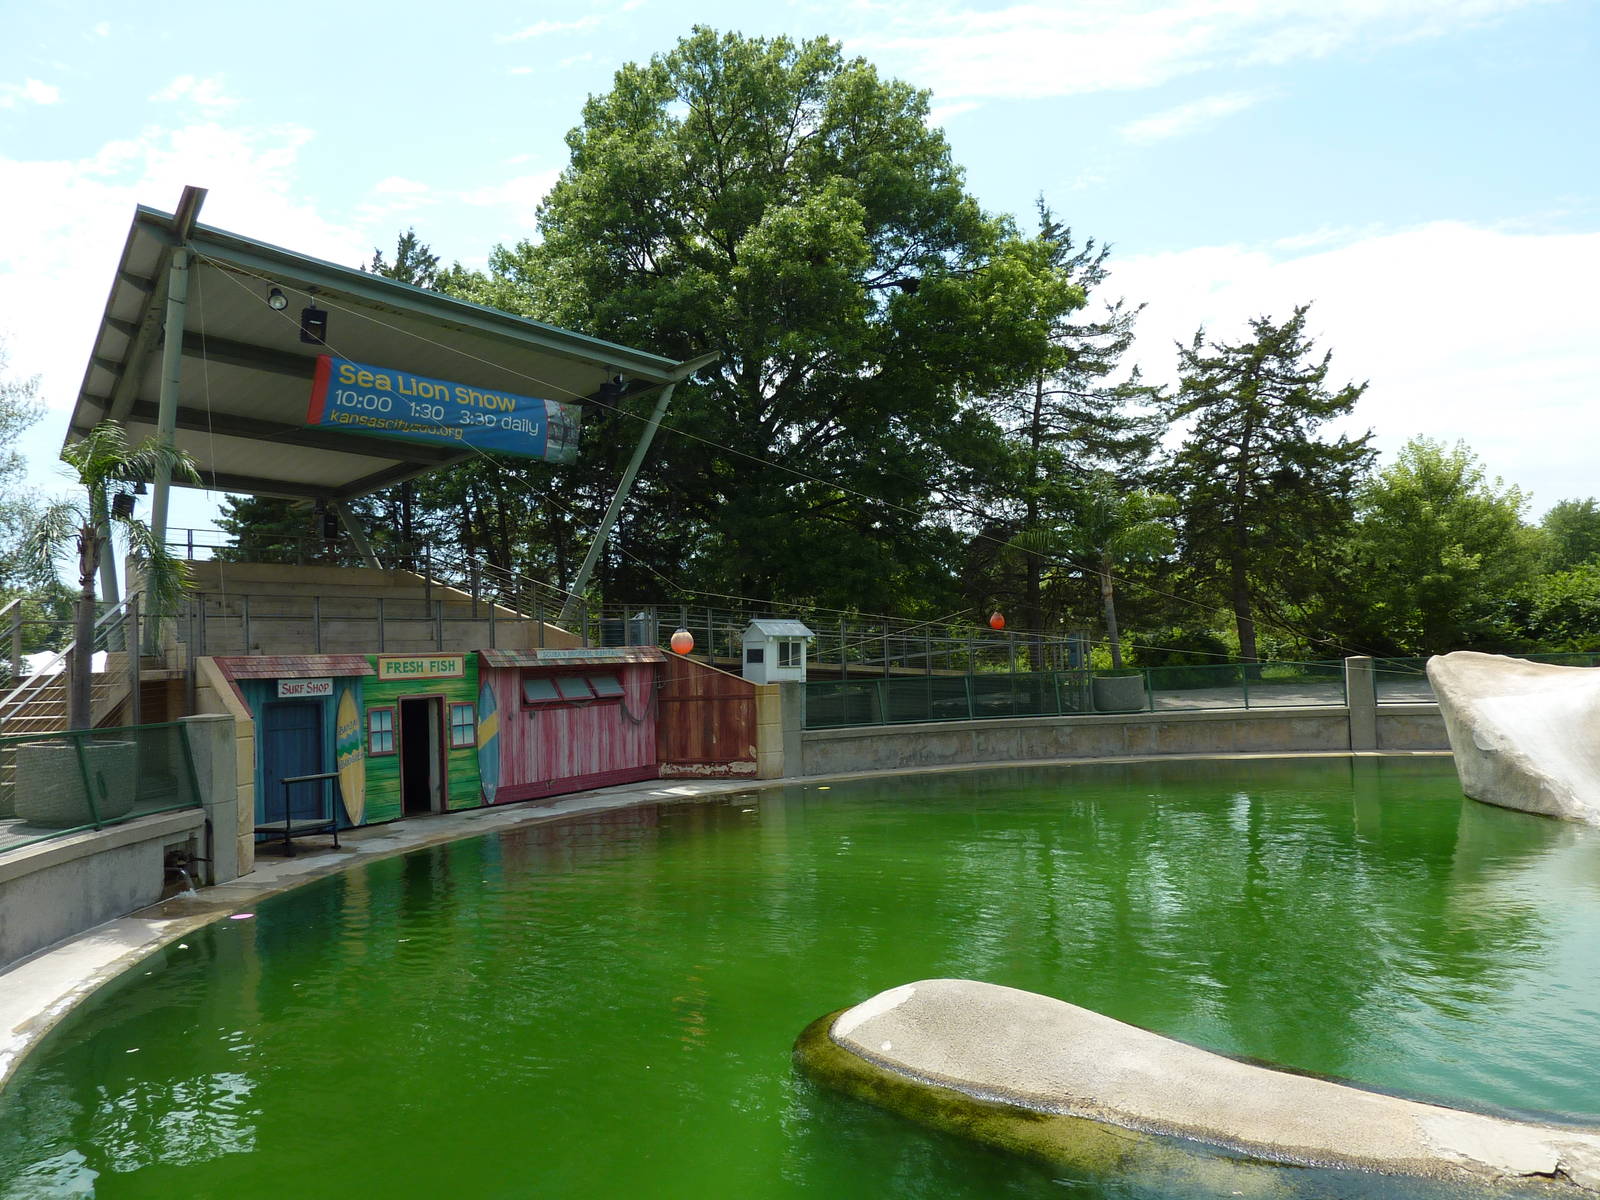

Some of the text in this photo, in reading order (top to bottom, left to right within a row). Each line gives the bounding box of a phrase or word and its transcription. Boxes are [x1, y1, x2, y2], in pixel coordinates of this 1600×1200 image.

[338, 364, 392, 391] Sea
[398, 375, 450, 402] Lion
[335, 389, 539, 436] 10:00 1:30 3:30 daily
[385, 660, 456, 673] FRESH FISH
[281, 681, 329, 695] SURF SHOP
